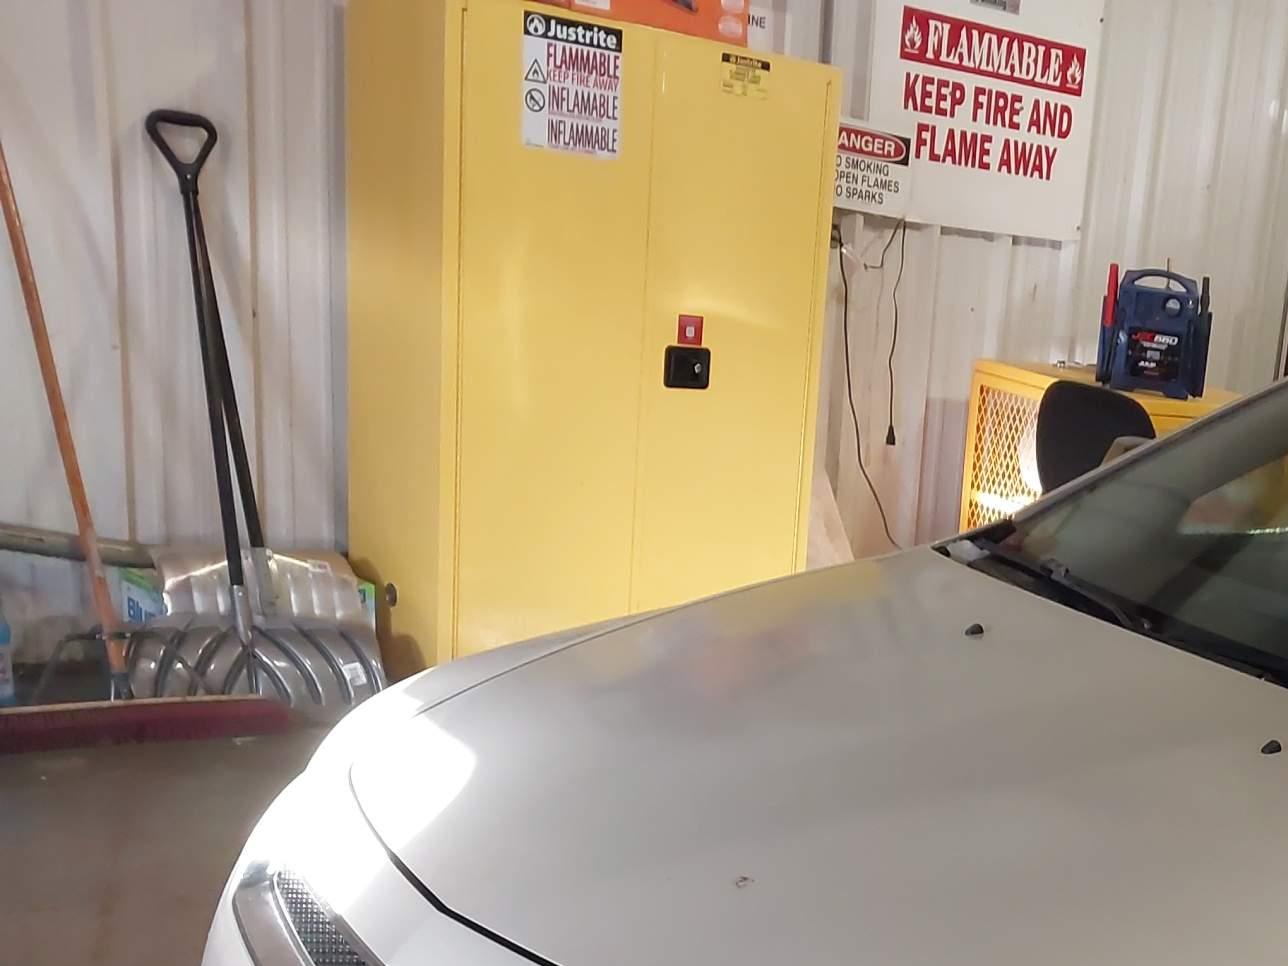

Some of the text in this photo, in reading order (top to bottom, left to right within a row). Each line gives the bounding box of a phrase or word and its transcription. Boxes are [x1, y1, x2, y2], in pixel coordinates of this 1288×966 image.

[547, 19, 617, 49] Justrite
[546, 42, 620, 80] FLAMMABLE
[926, 18, 1063, 87] FLAMMABLE
[547, 70, 619, 92] KEEP FIRE AWAY
[548, 85, 619, 121] INFLAMABLE
[903, 71, 1073, 140] KEEP FIRE AND
[547, 118, 618, 153] INFLAMMABLE
[838, 130, 896, 157] ANGER
[836, 154, 890, 177] O SMOKING
[914, 122, 1058, 182] FLAME AWAY
[835, 184, 884, 205] O SPARKS
[860, 174, 900, 194] FLAMES
